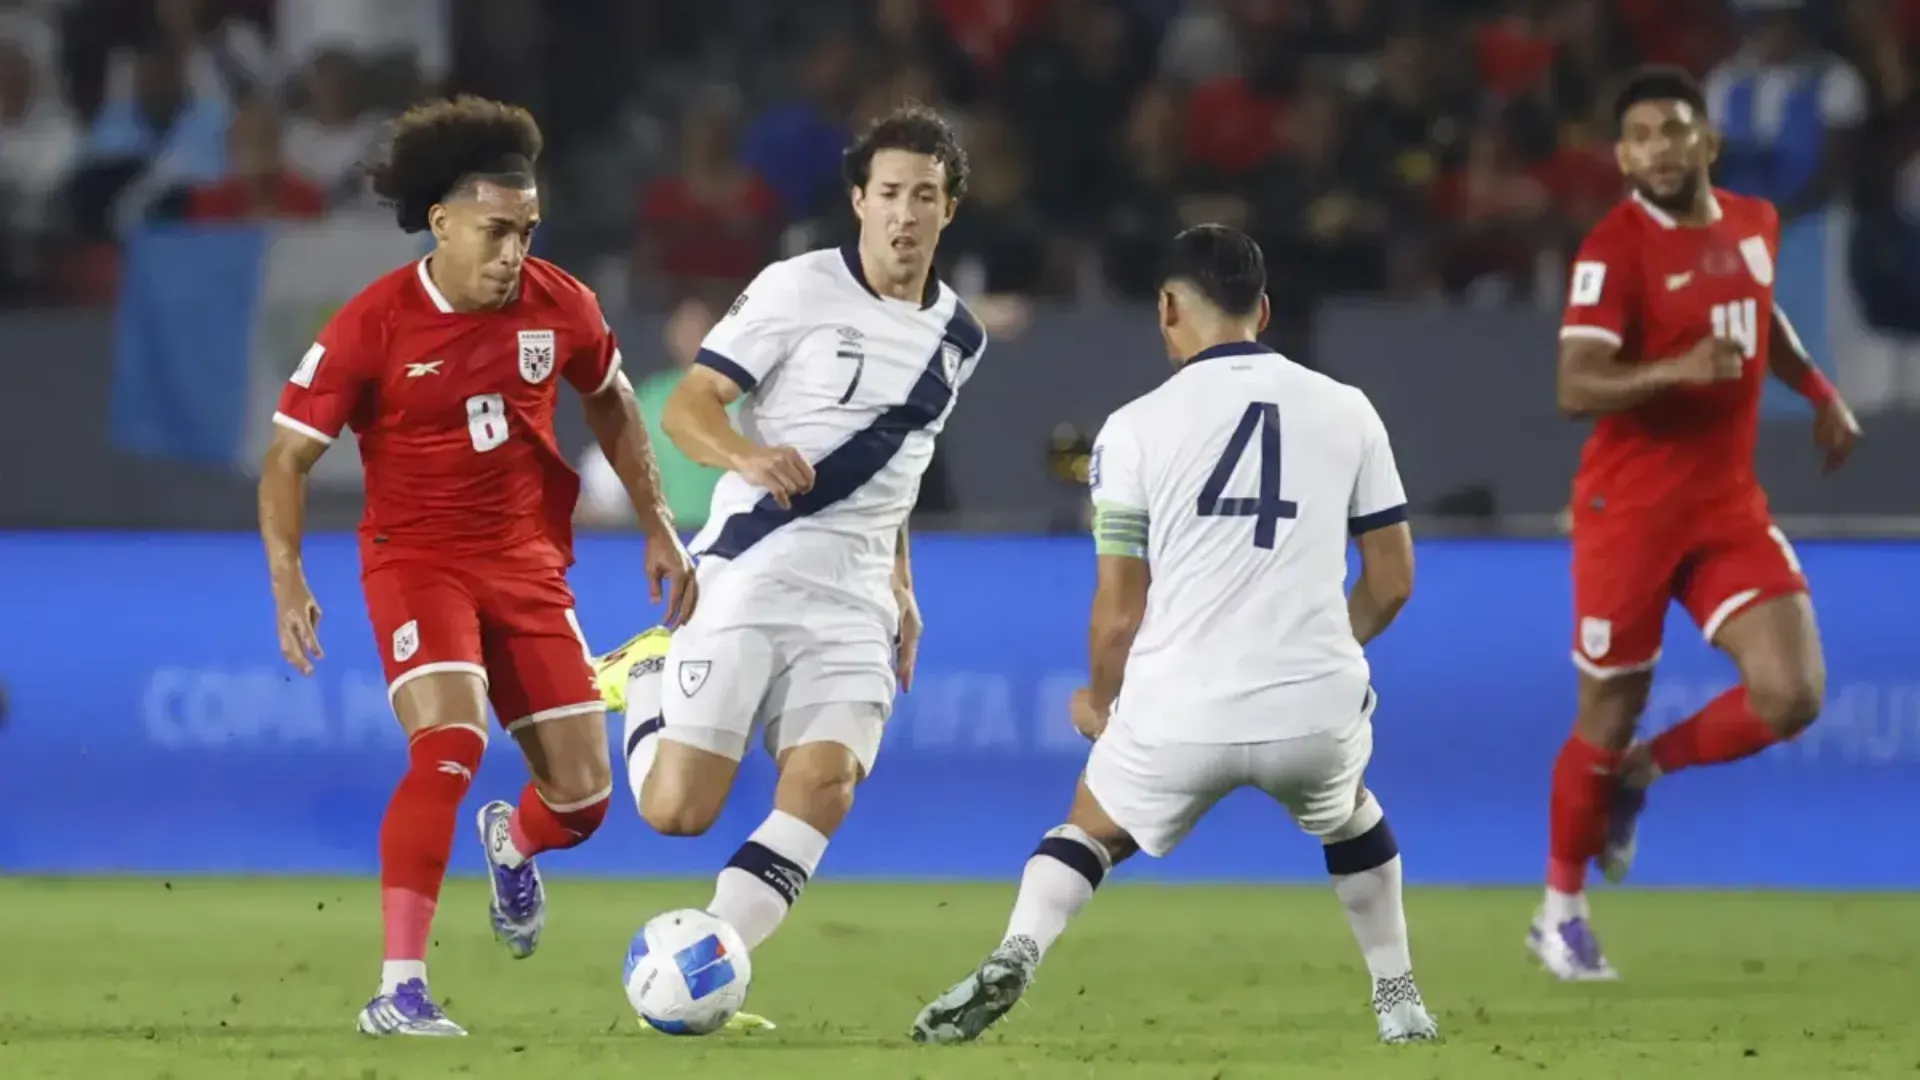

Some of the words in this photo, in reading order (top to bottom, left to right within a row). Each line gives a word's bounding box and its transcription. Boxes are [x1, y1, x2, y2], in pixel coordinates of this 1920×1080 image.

[1711, 298, 1757, 359] 14
[837, 350, 864, 404] 7
[466, 393, 510, 453] 8
[1197, 401, 1297, 549] 4
